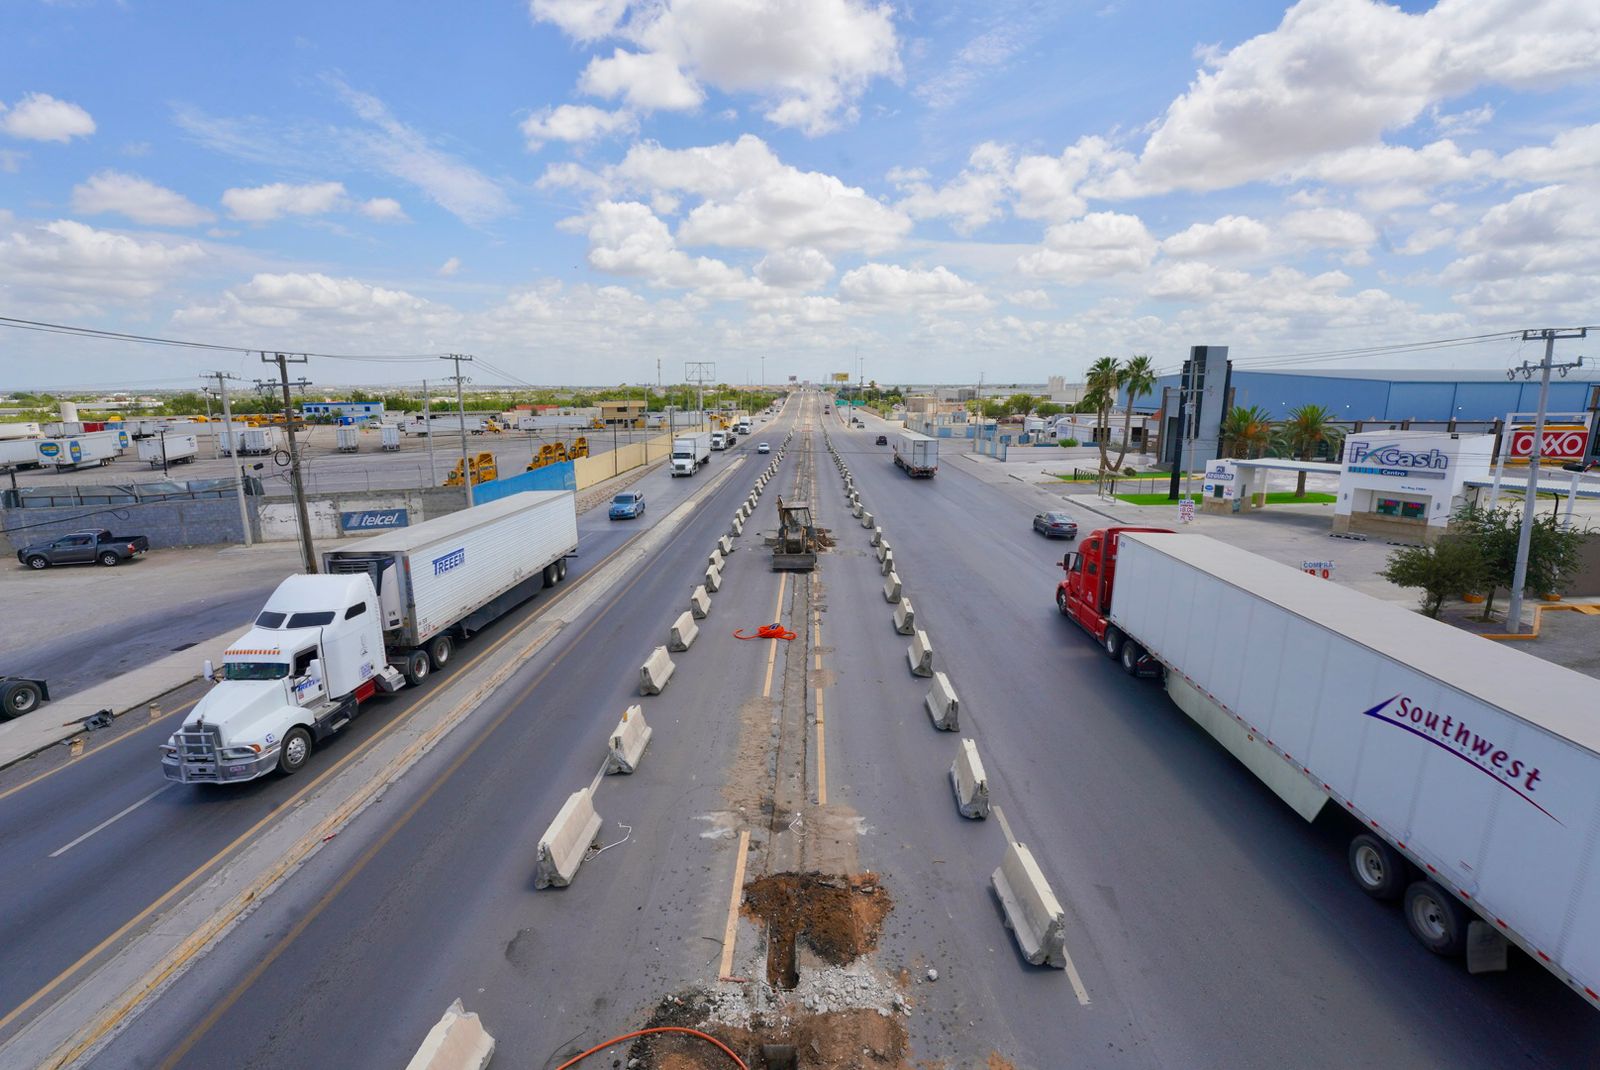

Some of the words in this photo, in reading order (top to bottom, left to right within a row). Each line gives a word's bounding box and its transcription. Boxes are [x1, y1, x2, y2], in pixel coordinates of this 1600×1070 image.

[1382, 469, 1405, 477] Centro
[361, 513, 399, 526] telcel
[1396, 697, 1542, 792] Southwest
